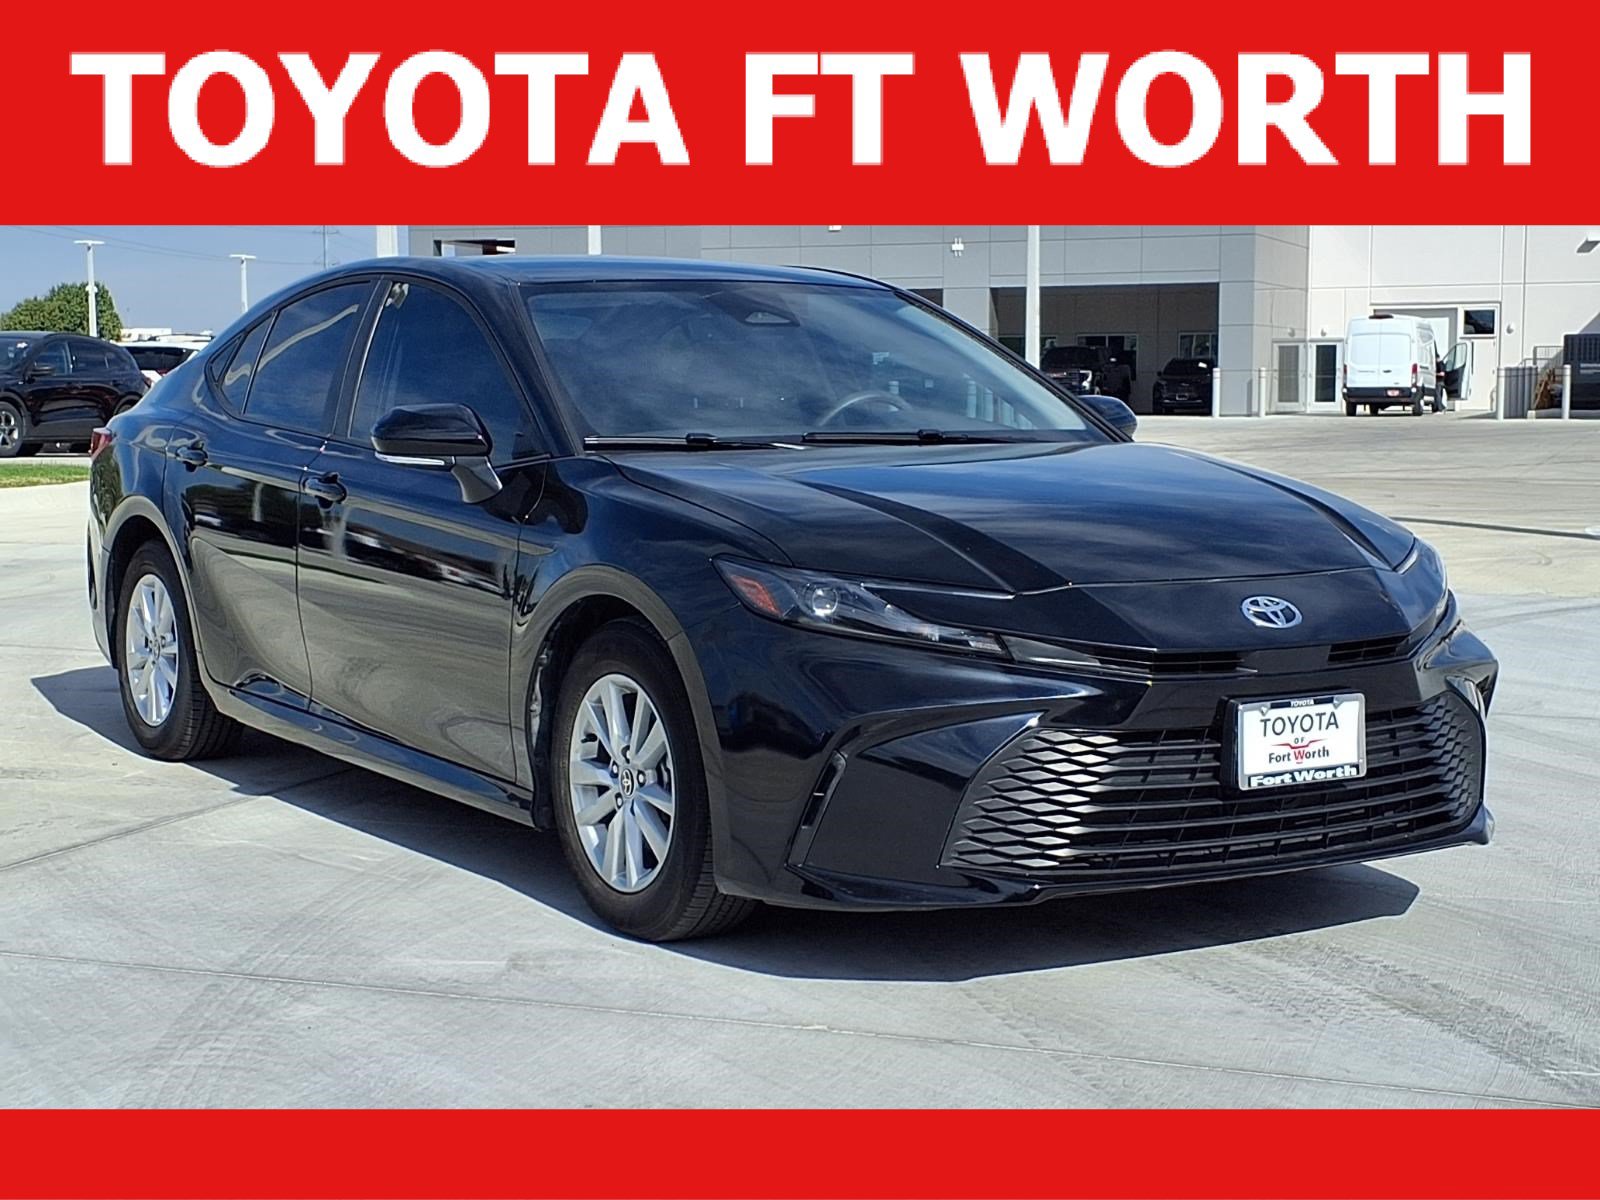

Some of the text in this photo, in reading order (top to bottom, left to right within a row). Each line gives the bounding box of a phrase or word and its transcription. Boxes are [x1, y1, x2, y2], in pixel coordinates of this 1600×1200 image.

[1290, 699, 1315, 707] TOYOTA
[1260, 711, 1339, 737] TOYOTA
[1293, 736, 1305, 745] OF
[1268, 746, 1330, 764] Fort Worth
[1250, 764, 1357, 788] Fort Worth
